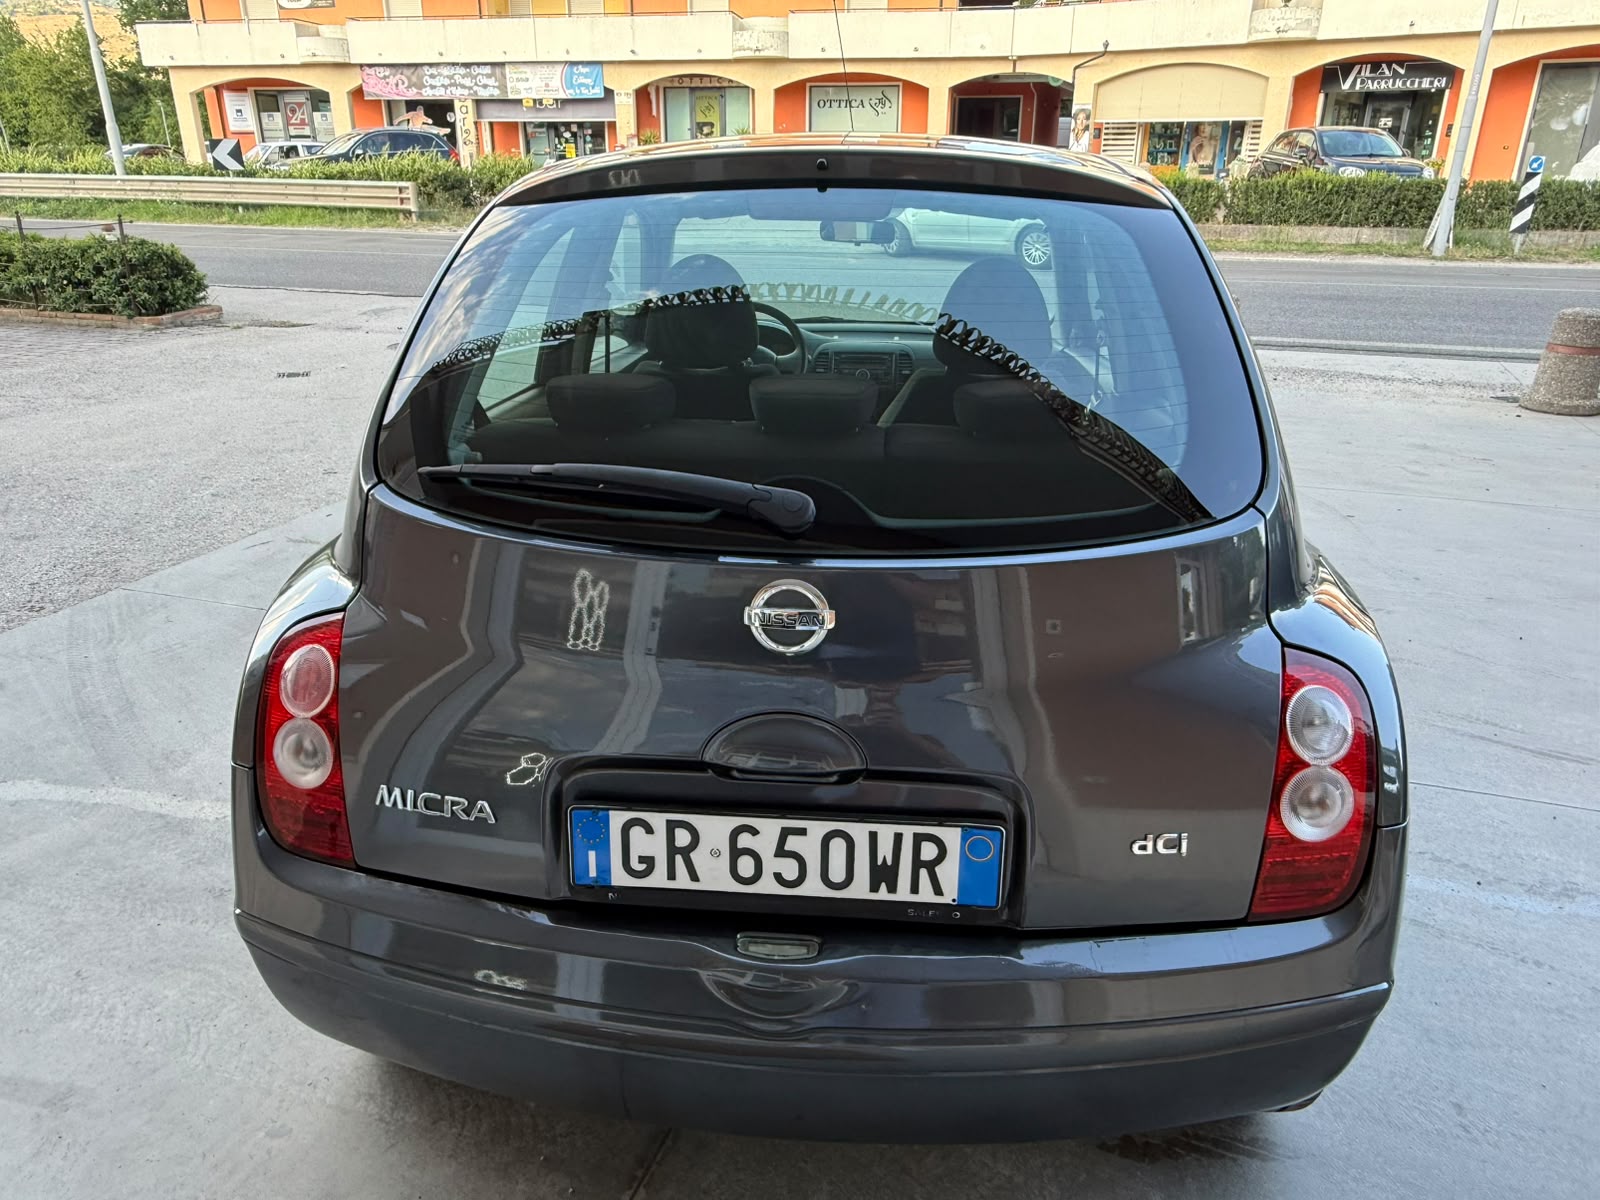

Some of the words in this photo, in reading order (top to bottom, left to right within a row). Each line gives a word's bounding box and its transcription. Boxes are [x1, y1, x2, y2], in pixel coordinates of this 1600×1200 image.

[1338, 63, 1406, 90] VILAN
[1355, 77, 1447, 90] PARRUCCHIERI
[287, 103, 310, 124] 24
[817, 98, 866, 109] OTTICA
[751, 611, 825, 627] NISSAN
[375, 784, 496, 824] MICRA
[620, 817, 701, 883] GR
